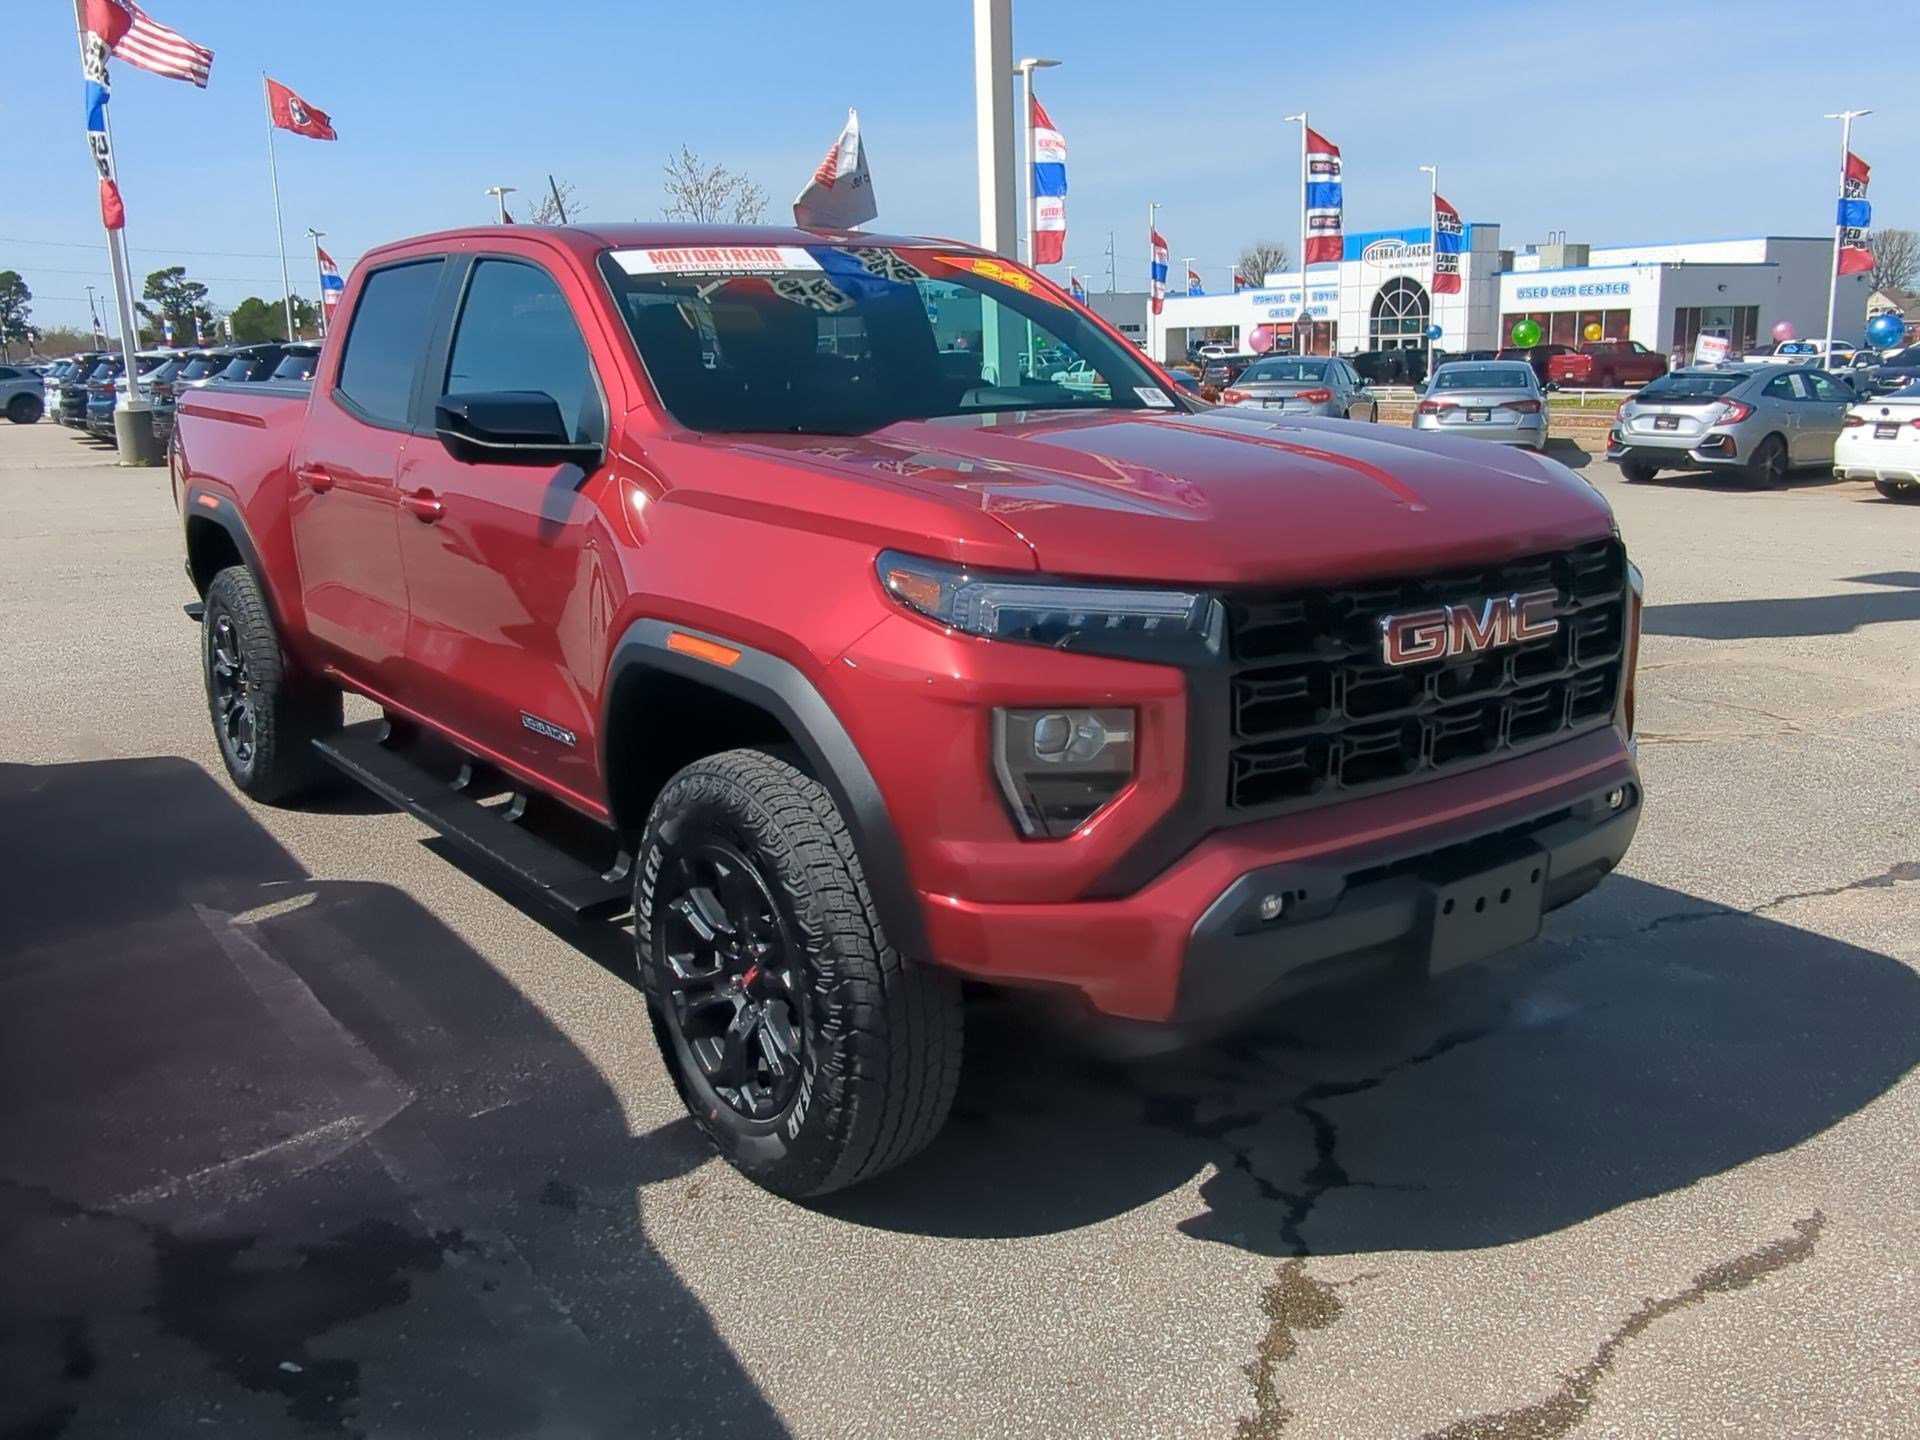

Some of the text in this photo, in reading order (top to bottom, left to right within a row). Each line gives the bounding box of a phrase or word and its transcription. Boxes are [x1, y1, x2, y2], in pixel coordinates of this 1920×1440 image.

[1437, 213, 1459, 224] USE
[1438, 223, 1463, 234] CARS
[647, 248, 783, 265] MOTORTREND
[1371, 247, 1394, 261] SERRA
[1406, 245, 1431, 258] JACKS
[656, 263, 724, 272] CERTIFIED
[725, 262, 788, 270] VEHICLES
[1436, 264, 1457, 273] CAR
[1517, 282, 1631, 299] USED CAR CENTER
[1380, 588, 1559, 666] GMC
